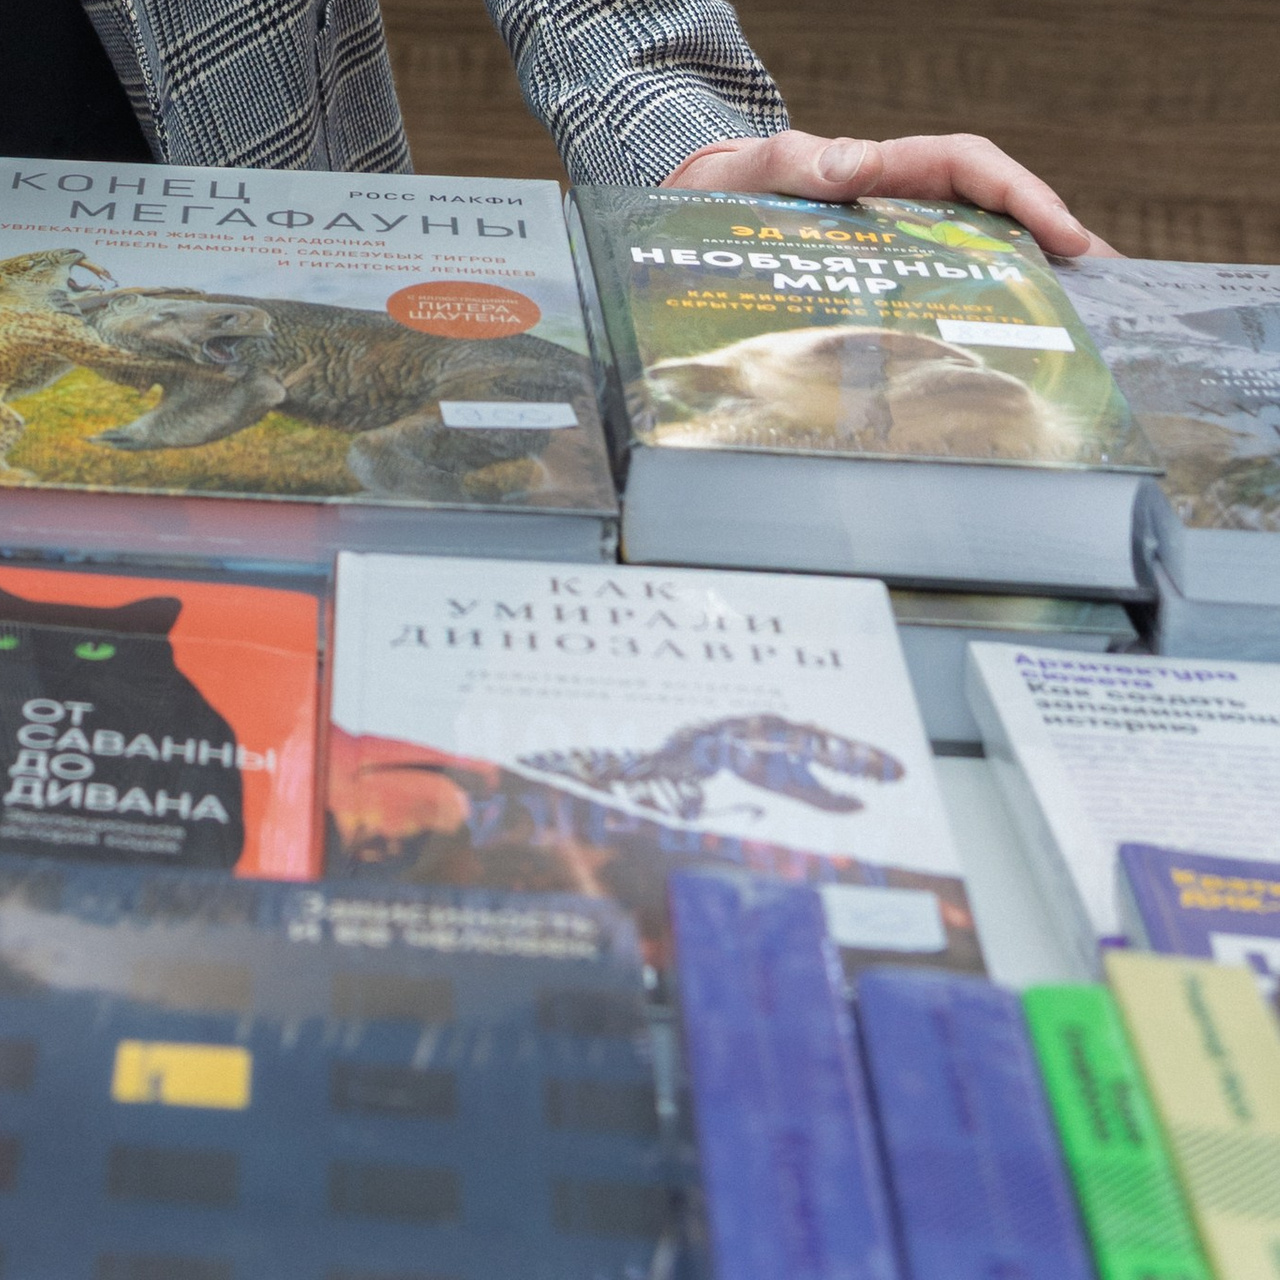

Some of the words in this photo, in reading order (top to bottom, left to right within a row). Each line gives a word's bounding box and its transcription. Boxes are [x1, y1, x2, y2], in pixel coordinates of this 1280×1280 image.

[11, 171, 251, 204] КОНЕЦ
[349, 190, 416, 201] РОСС
[428, 194, 524, 206] МАКФИ
[648, 193, 759, 205] БЕСТСЕЛЛЕР
[904, 206, 957, 215] TIMES
[70, 200, 528, 239] МЕГАФАУНЫ
[0, 223, 158, 237] УВЛЕКАТЕЛЬНАЯ
[166, 231, 235, 241] ЖИЗНЬ
[242, 234, 256, 242] И
[263, 235, 387, 248] ЗАГАДОЧНАЯ
[730, 225, 785, 241] ЭД
[798, 226, 898, 244] ЙОНГ
[94, 239, 169, 249] ГИБЕЛЬ
[297, 248, 424, 261] САБЛЕЗУБЫХ
[431, 254, 507, 265] ТИГРОВ
[630, 246, 1026, 282] НЕОБЪЯТНЫЙ
[276, 259, 291, 268] И
[298, 260, 423, 273] ГИГАНТСКИХ
[429, 266, 537, 278] ЛЕНИВЦЕВ
[772, 272, 898, 295] МИР
[418, 301, 511, 314] ПИТЕРА
[665, 298, 777, 313] СКРЫТУЮ
[786, 304, 814, 315] ОТ
[824, 306, 870, 318] НАС
[878, 309, 1026, 325] РЕАЛЬНОСТЬ
[686, 290, 729, 300] КАК
[738, 291, 864, 307] ЖИВОТНЫЕ
[873, 299, 995, 314] ОЩУЩАЮТ
[408, 310, 522, 324] ШАУТЕНА
[549, 576, 678, 602] КАК
[446, 597, 784, 635] УМИРАЛИ
[392, 623, 843, 670] ДИНОЗАВРЫ
[1014, 653, 1239, 682] Архитектура
[1027, 680, 1091, 697] Как
[21, 697, 94, 727] ОТ
[16, 723, 277, 775] САВАННЫ
[7, 748, 96, 781] ДО
[2, 776, 231, 825] ДИВАНА
